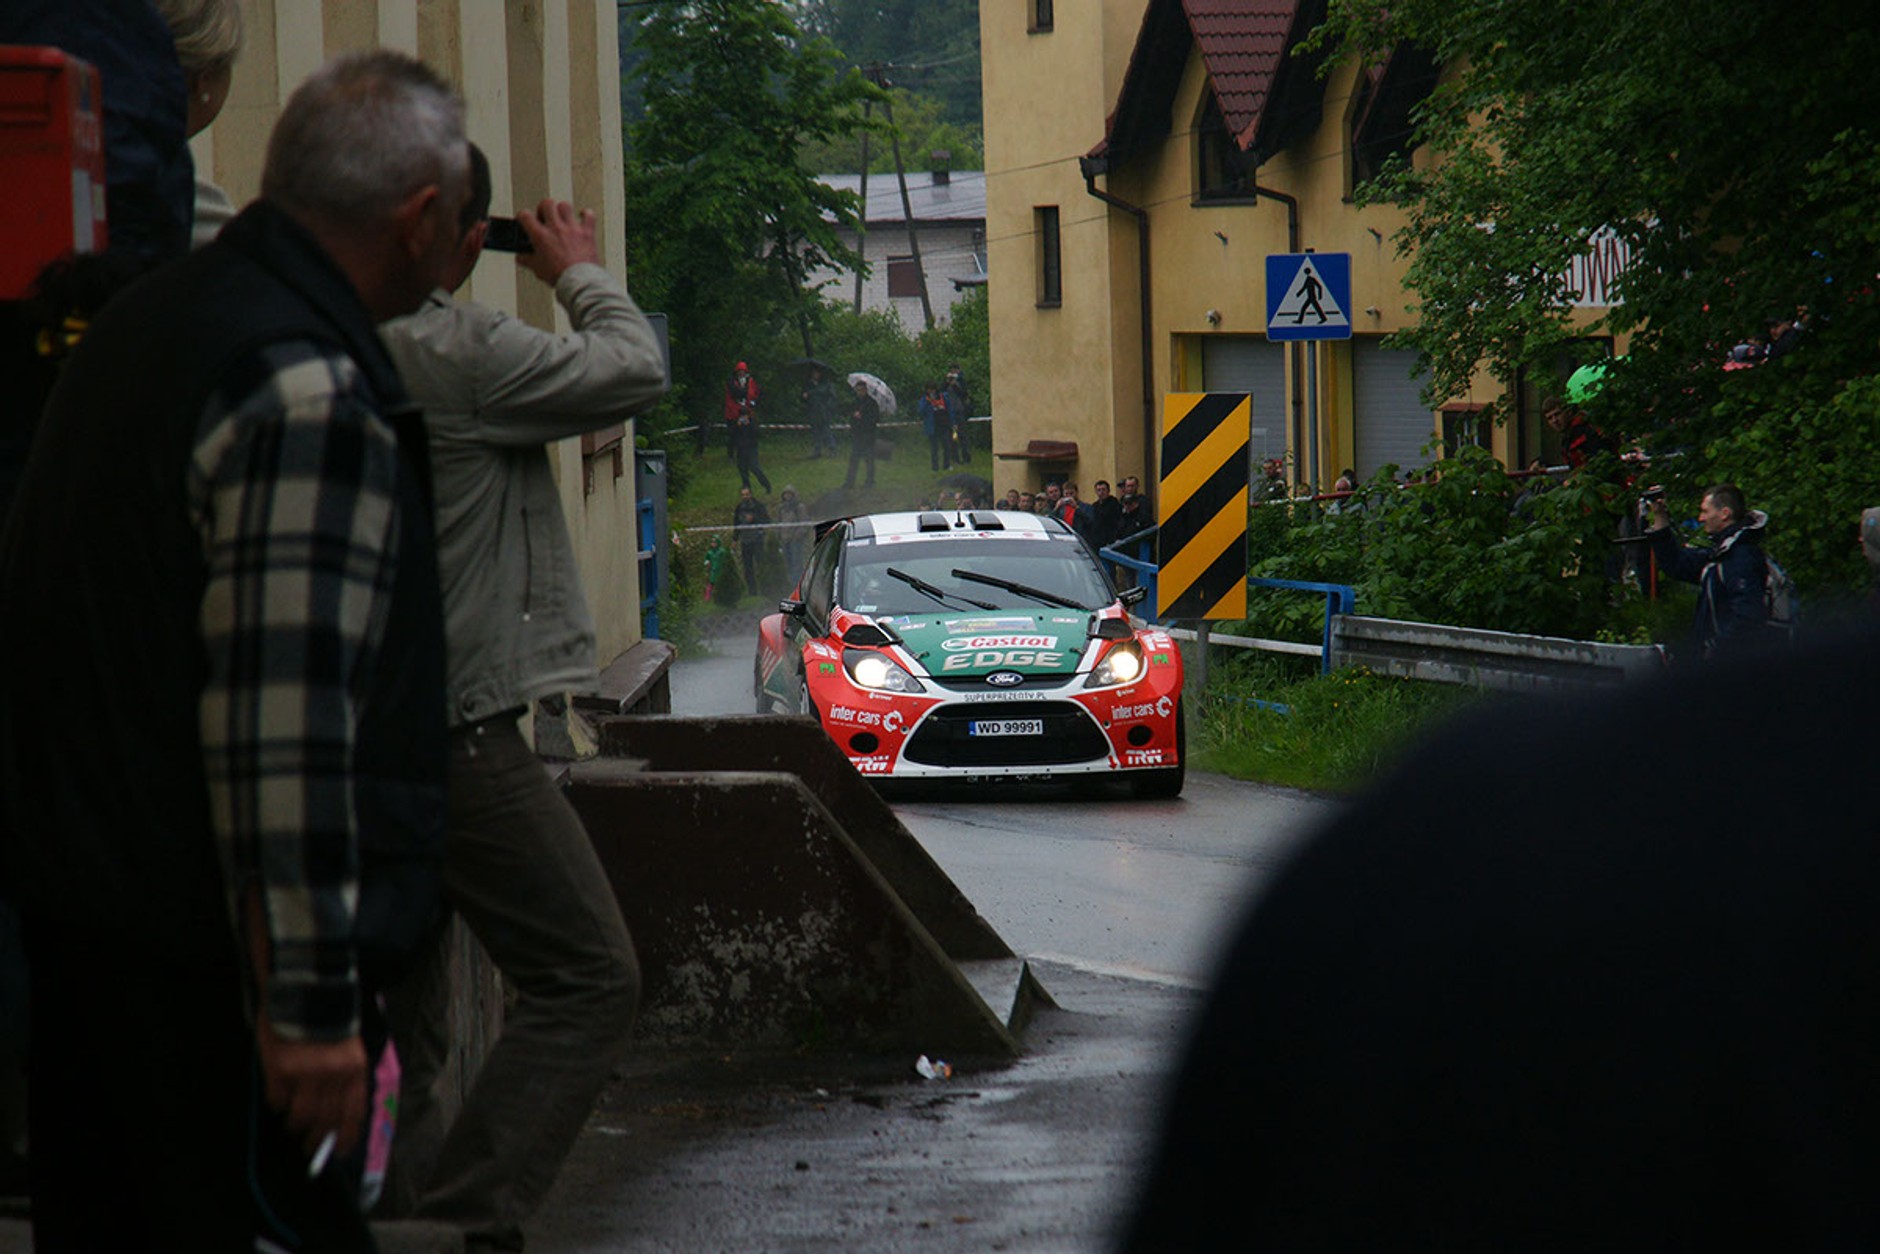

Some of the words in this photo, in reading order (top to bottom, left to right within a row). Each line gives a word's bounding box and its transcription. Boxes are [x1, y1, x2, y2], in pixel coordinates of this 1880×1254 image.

[970, 636, 1050, 648] Castrol
[942, 651, 1065, 671] EDGE
[829, 704, 857, 722] inter
[857, 709, 881, 725] cars
[1111, 704, 1133, 720] inter
[1134, 703, 1155, 717] cars
[977, 722, 1001, 734] WD
[1004, 722, 1041, 734] 99991
[848, 755, 890, 772] TRW
[1125, 749, 1163, 765] TRW
